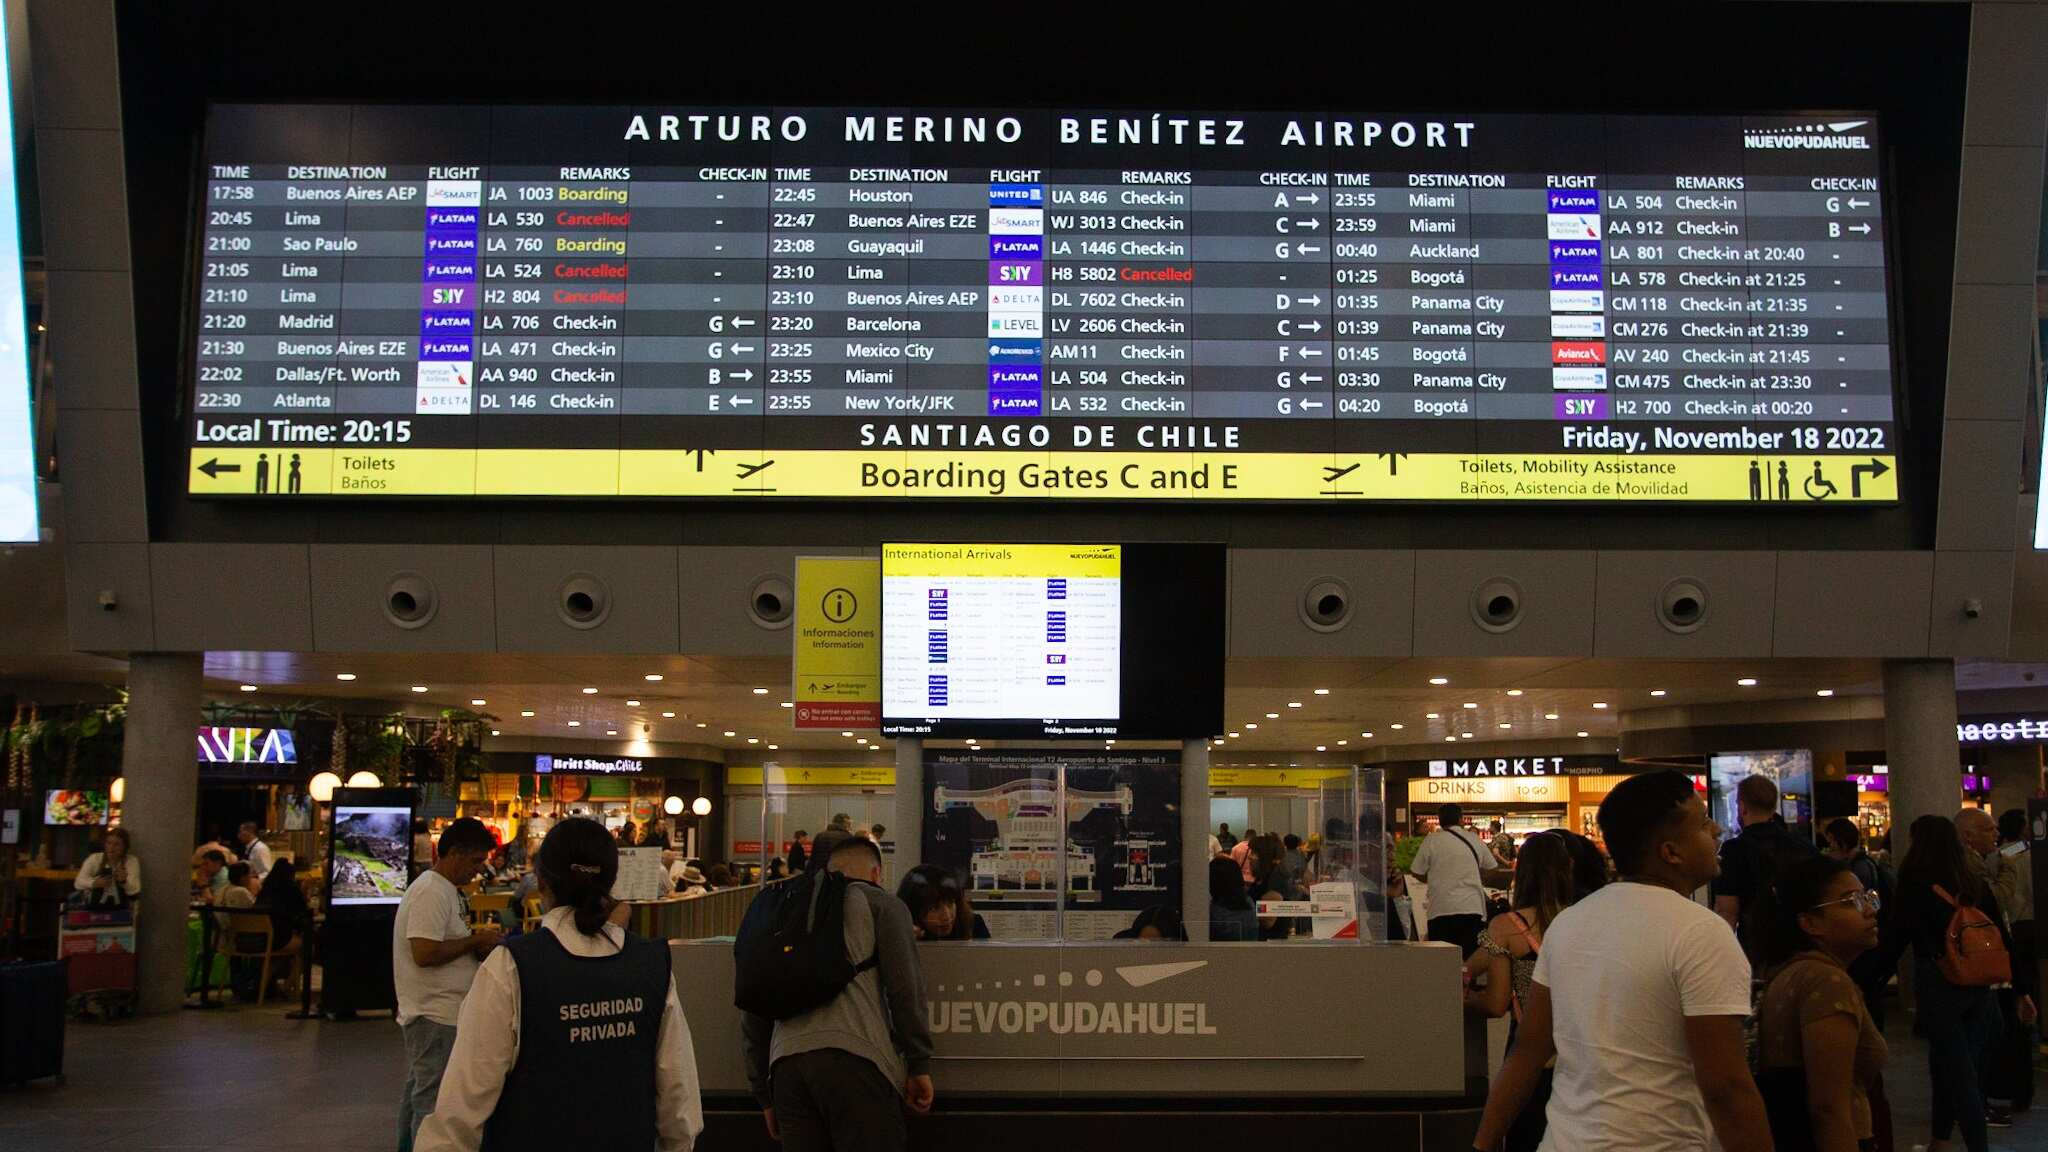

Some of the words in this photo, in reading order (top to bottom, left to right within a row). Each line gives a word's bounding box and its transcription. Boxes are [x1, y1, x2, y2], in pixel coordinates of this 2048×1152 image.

[624, 116, 806, 141] ARTURO
[846, 117, 1021, 142] MERINO
[1061, 114, 1244, 144] BENÍTEZ
[1281, 121, 1474, 147] AIRPORT
[1745, 136, 1869, 148] NUEVOPUDAHUEL
[214, 166, 249, 178] TIME
[289, 167, 385, 178] DESTINATION
[429, 167, 479, 179] FLIGHT
[561, 168, 630, 179] REMARKS
[699, 168, 766, 180] CHECK-IN
[775, 169, 810, 180] TIME
[850, 169, 947, 181] DESTINATION
[991, 170, 1040, 182] FLIGHT
[1123, 172, 1191, 183] REMARKS
[1260, 173, 1326, 185] CHECK-IN
[1335, 174, 1370, 185] TIME
[1409, 174, 1505, 186] DESTINATION
[1547, 176, 1596, 187] FLIGHT
[1677, 177, 1744, 189] REMARKS
[1811, 178, 1876, 190] CHECK-IN
[214, 187, 253, 199] 17:58
[287, 187, 341, 199] Buenos
[345, 187, 383, 199] Aires
[386, 187, 416, 200] AEP
[850, 189, 912, 202] Houston
[1410, 194, 1454, 206] Miami
[211, 212, 251, 224] 20:45
[286, 212, 320, 225] Lima
[849, 214, 903, 227] Buenos
[907, 214, 945, 227] Aires
[950, 215, 976, 228] EZE
[1410, 219, 1455, 232] Miami
[209, 237, 250, 250] 21:00
[284, 238, 311, 250] Sao
[316, 238, 357, 250] Paulo
[848, 240, 923, 256] Guayaquil
[1410, 244, 1479, 257] Auckland
[208, 264, 248, 276] 21:05
[283, 263, 317, 276] Lima
[848, 266, 883, 279] Lima
[1412, 270, 1464, 286] Bogotá
[206, 290, 247, 302] 21:10
[281, 289, 316, 302] Lima
[848, 292, 902, 304] Buenos
[906, 292, 943, 305] Aires
[948, 292, 978, 305] AEP
[1412, 296, 1471, 309] Panama
[1476, 296, 1504, 312] City
[204, 315, 245, 328] 21:20
[280, 315, 333, 328] Madrid
[847, 317, 921, 330] Barcelona
[1005, 320, 1039, 330] LEVEL
[1413, 321, 1471, 334] Panama
[1477, 321, 1505, 338] City
[203, 341, 244, 354] 21:30
[278, 342, 332, 354] Buenos
[336, 341, 374, 355] Aires
[380, 342, 406, 355] EZE
[847, 343, 900, 357] Mexico
[905, 344, 934, 360] City
[1413, 348, 1466, 364] Bogotá
[1558, 349, 1591, 358] Avianca
[201, 368, 242, 380] 22:02
[277, 367, 346, 384] Dallas/Ft.
[352, 368, 400, 381] Worth
[846, 369, 892, 383] Miami
[1414, 374, 1472, 387] Panama
[1478, 374, 1506, 390] City
[199, 394, 241, 406] 22:30
[274, 394, 330, 407] Atlanta
[432, 397, 471, 405] DELTA
[846, 396, 880, 409] New
[885, 396, 954, 412] York/JFK
[1415, 399, 1468, 416] Bogotá
[197, 419, 260, 441] Local
[268, 420, 336, 441] Time:
[343, 420, 410, 442] 20:15
[861, 424, 1049, 446] SANTIAGO
[1074, 426, 1114, 446] DE
[1138, 426, 1238, 447] CHILE
[1563, 429, 1648, 450] Friday,
[1655, 427, 1783, 448] November
[1791, 428, 1819, 449] 18
[1826, 428, 1884, 448] 2022
[343, 457, 395, 470] Toilets
[1460, 460, 1516, 475] Toilets,
[1524, 460, 1588, 476] Mobility
[1594, 461, 1675, 473] Assistance
[342, 476, 386, 489] Baños
[861, 462, 1005, 493] Boarding
[1019, 464, 1107, 488] Gates
[1121, 464, 1138, 488] C
[1151, 463, 1208, 488] and
[1223, 465, 1237, 488] E
[1461, 481, 1508, 495] Baños,
[1515, 481, 1586, 494] Asistencia
[1593, 482, 1610, 494] de
[1616, 482, 1687, 494] Movilidad
[886, 549, 962, 558] International
[966, 550, 1012, 559] Arrivals
[804, 628, 874, 638] Informaciones
[813, 640, 864, 648] Information
[553, 758, 583, 769] Britt
[1453, 758, 1564, 776] MARKET
[1569, 767, 1604, 775] MORPHO
[1428, 781, 1485, 794] DRINKS
[1517, 786, 1530, 794] TO
[1533, 786, 1548, 794] GO
[560, 998, 642, 1022] SEGURIDAD
[928, 1001, 1217, 1034] UEVOPUDAHUEL
[571, 1021, 635, 1042] PRIVADA
